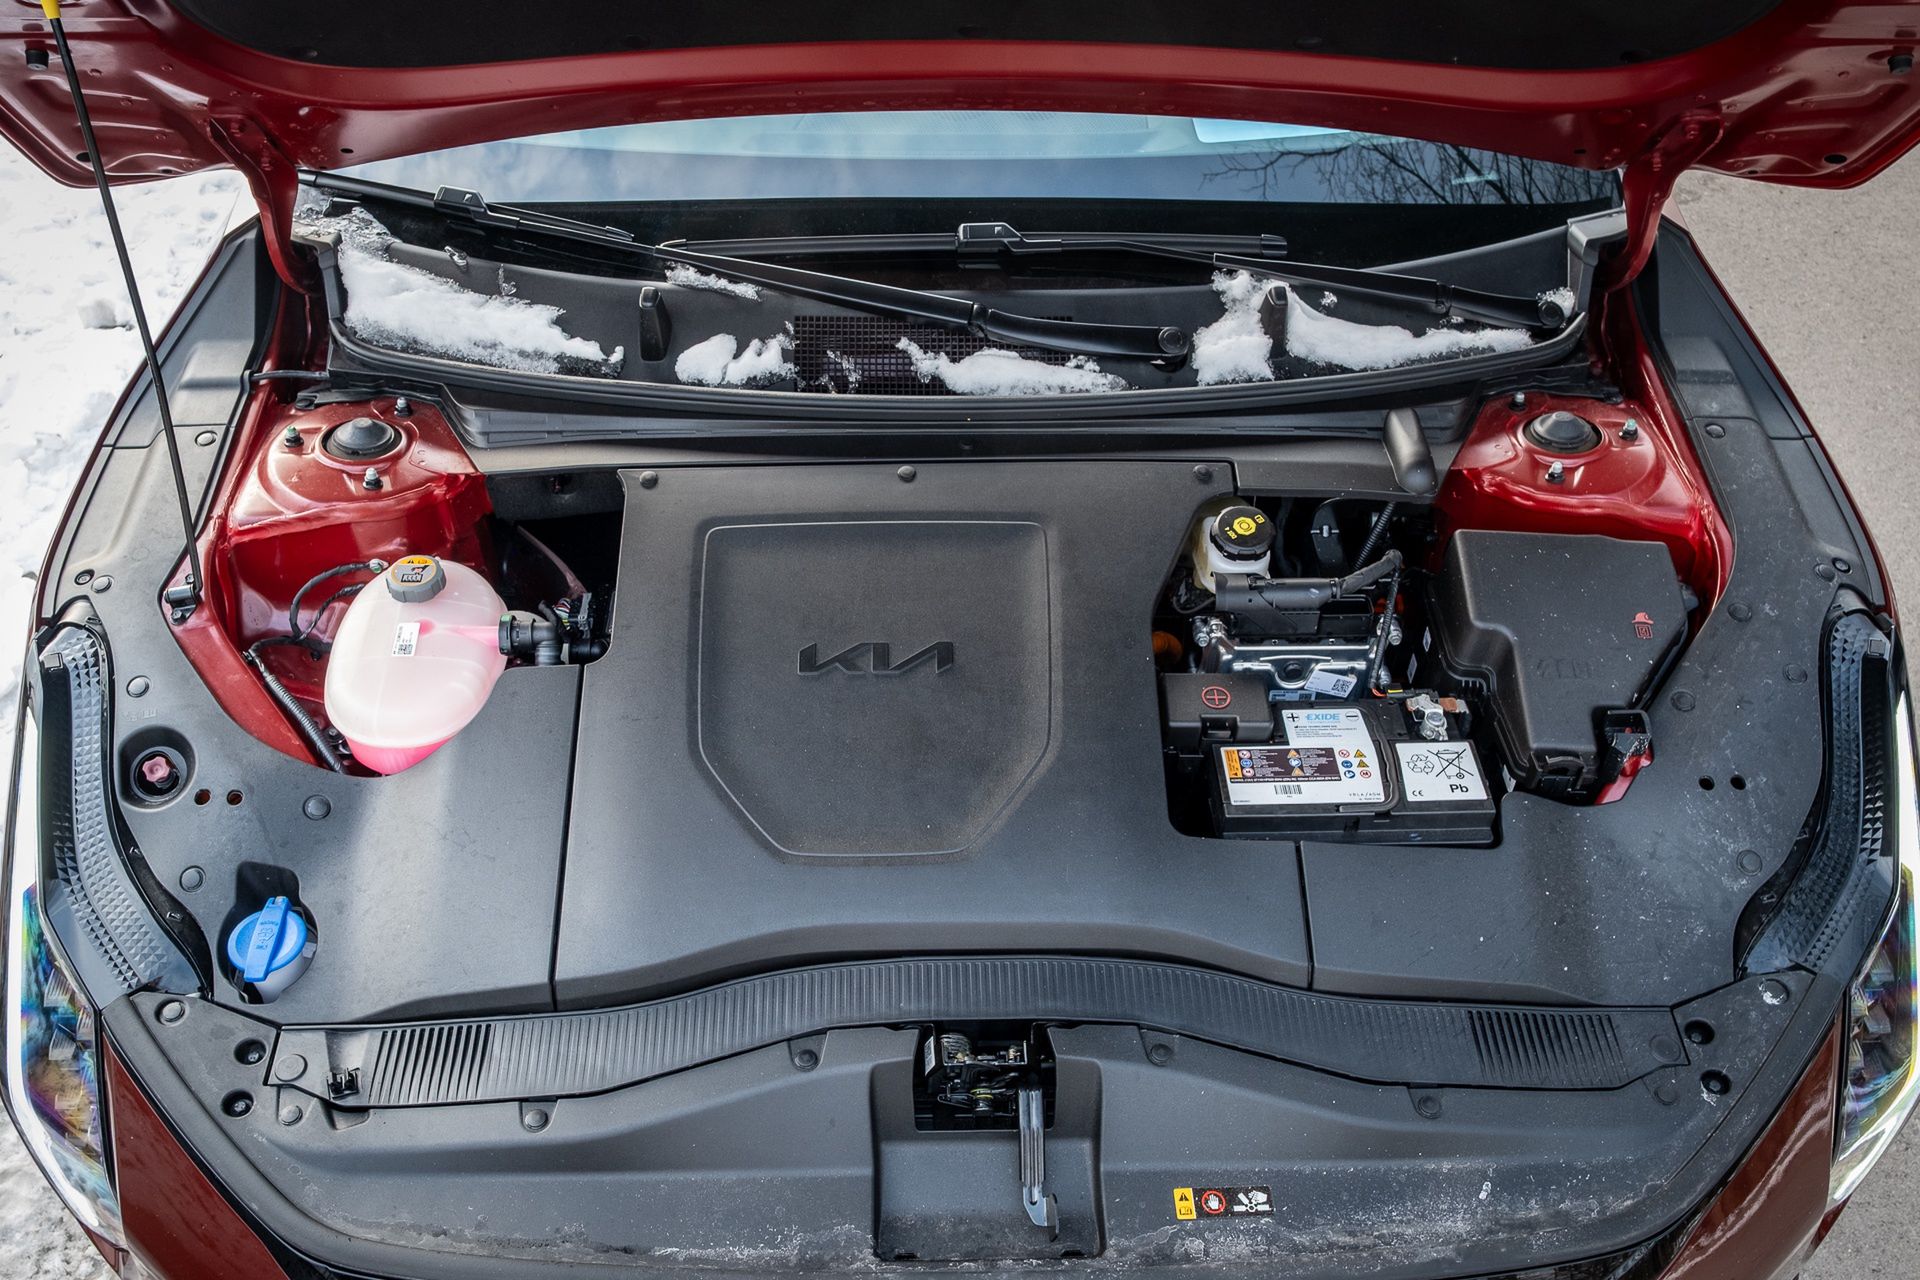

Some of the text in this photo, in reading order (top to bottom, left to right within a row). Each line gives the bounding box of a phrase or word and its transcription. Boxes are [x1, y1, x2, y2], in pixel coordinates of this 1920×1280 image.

[798, 640, 954, 675] KIA
[1305, 713, 1340, 721] EXIDE
[1449, 784, 1469, 793] Pb
